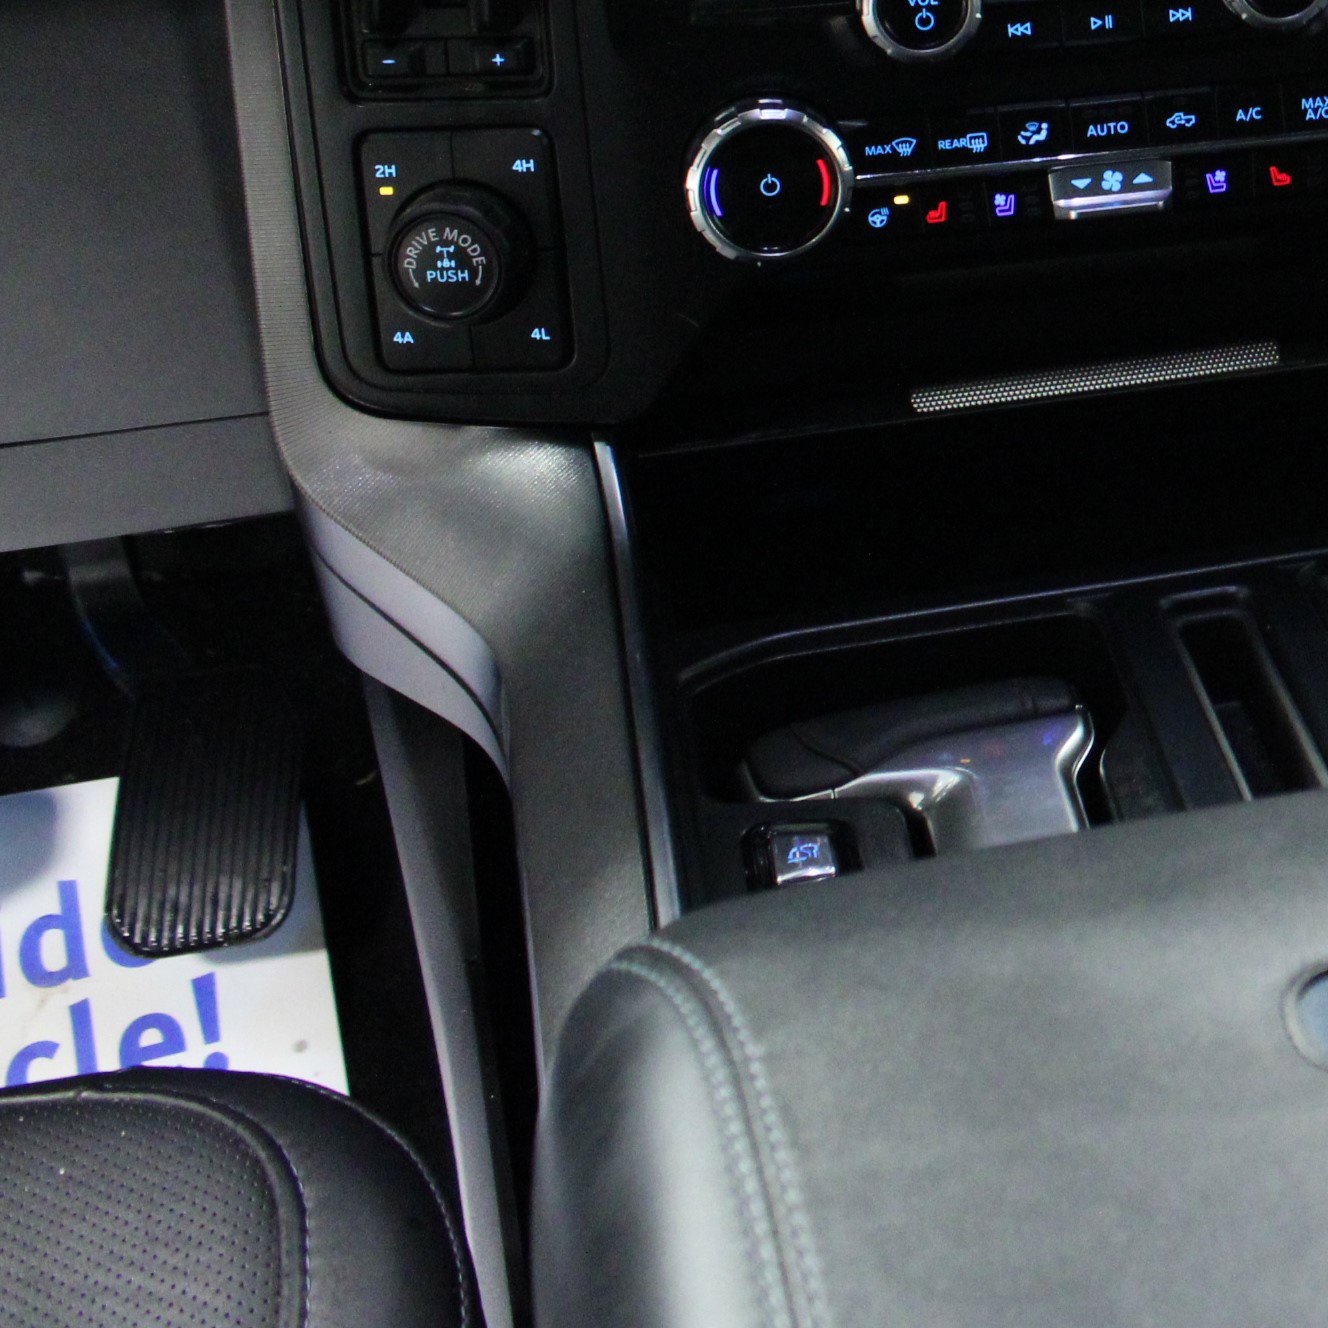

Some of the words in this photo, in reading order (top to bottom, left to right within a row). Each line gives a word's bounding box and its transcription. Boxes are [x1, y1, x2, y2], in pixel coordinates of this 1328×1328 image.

[1235, 106, 1262, 122] A/C
[1086, 121, 1129, 137] AUTO
[865, 144, 892, 156] MAX
[937, 137, 967, 150] REAR
[374, 164, 397, 178] 2H
[512, 158, 535, 173] 4H
[404, 227, 439, 270] DRIVE
[443, 227, 486, 267] MODE
[426, 269, 469, 283] PUSH
[393, 331, 415, 344] 4A
[530, 327, 551, 341] 4L
